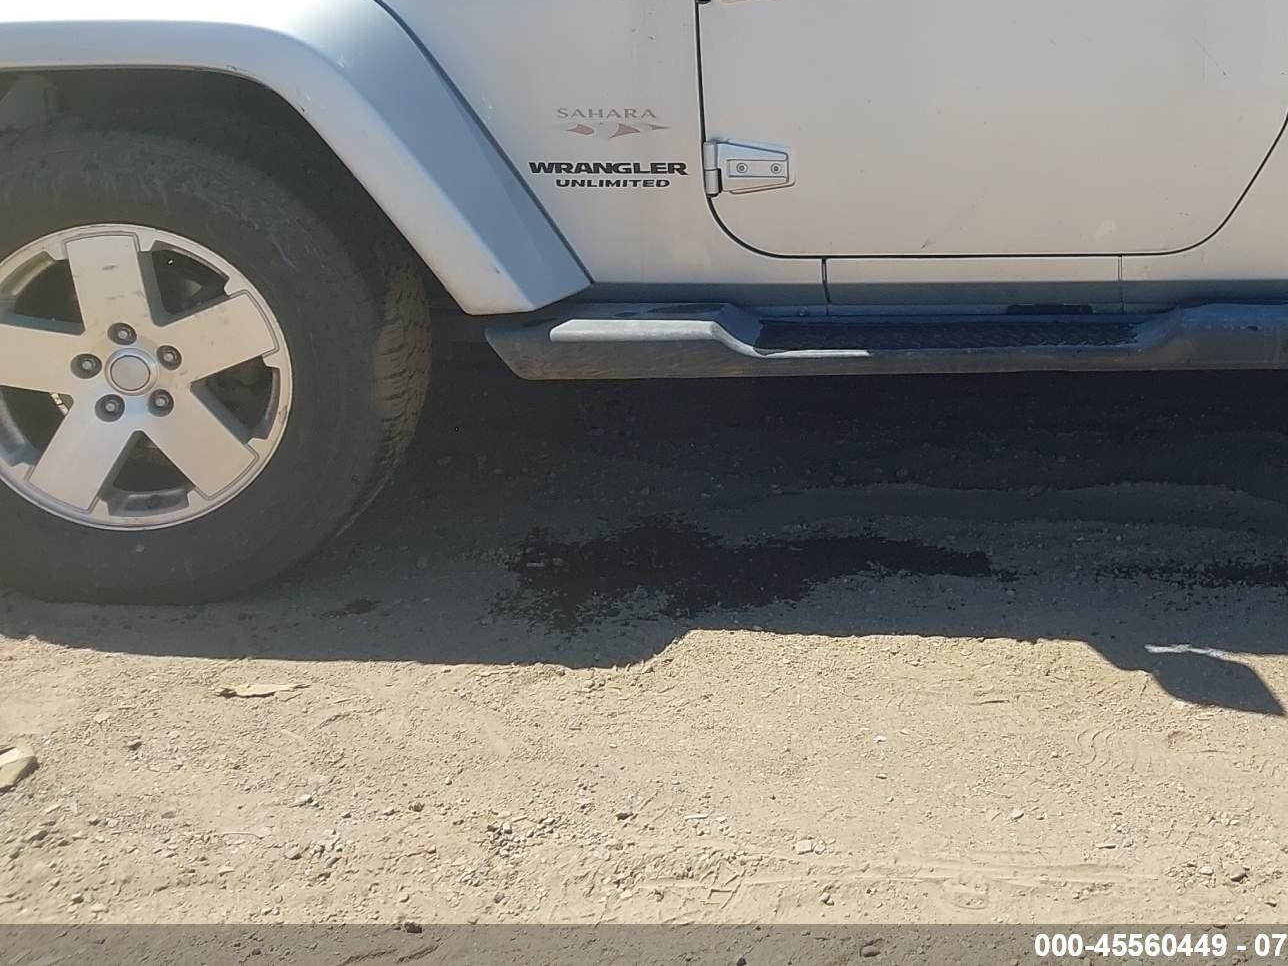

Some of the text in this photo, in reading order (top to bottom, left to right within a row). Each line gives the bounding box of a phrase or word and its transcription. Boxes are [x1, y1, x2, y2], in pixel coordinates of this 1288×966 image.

[557, 108, 657, 119] SAHARA
[529, 162, 688, 176] WRANGLER
[556, 179, 670, 188] UNLIMITED
